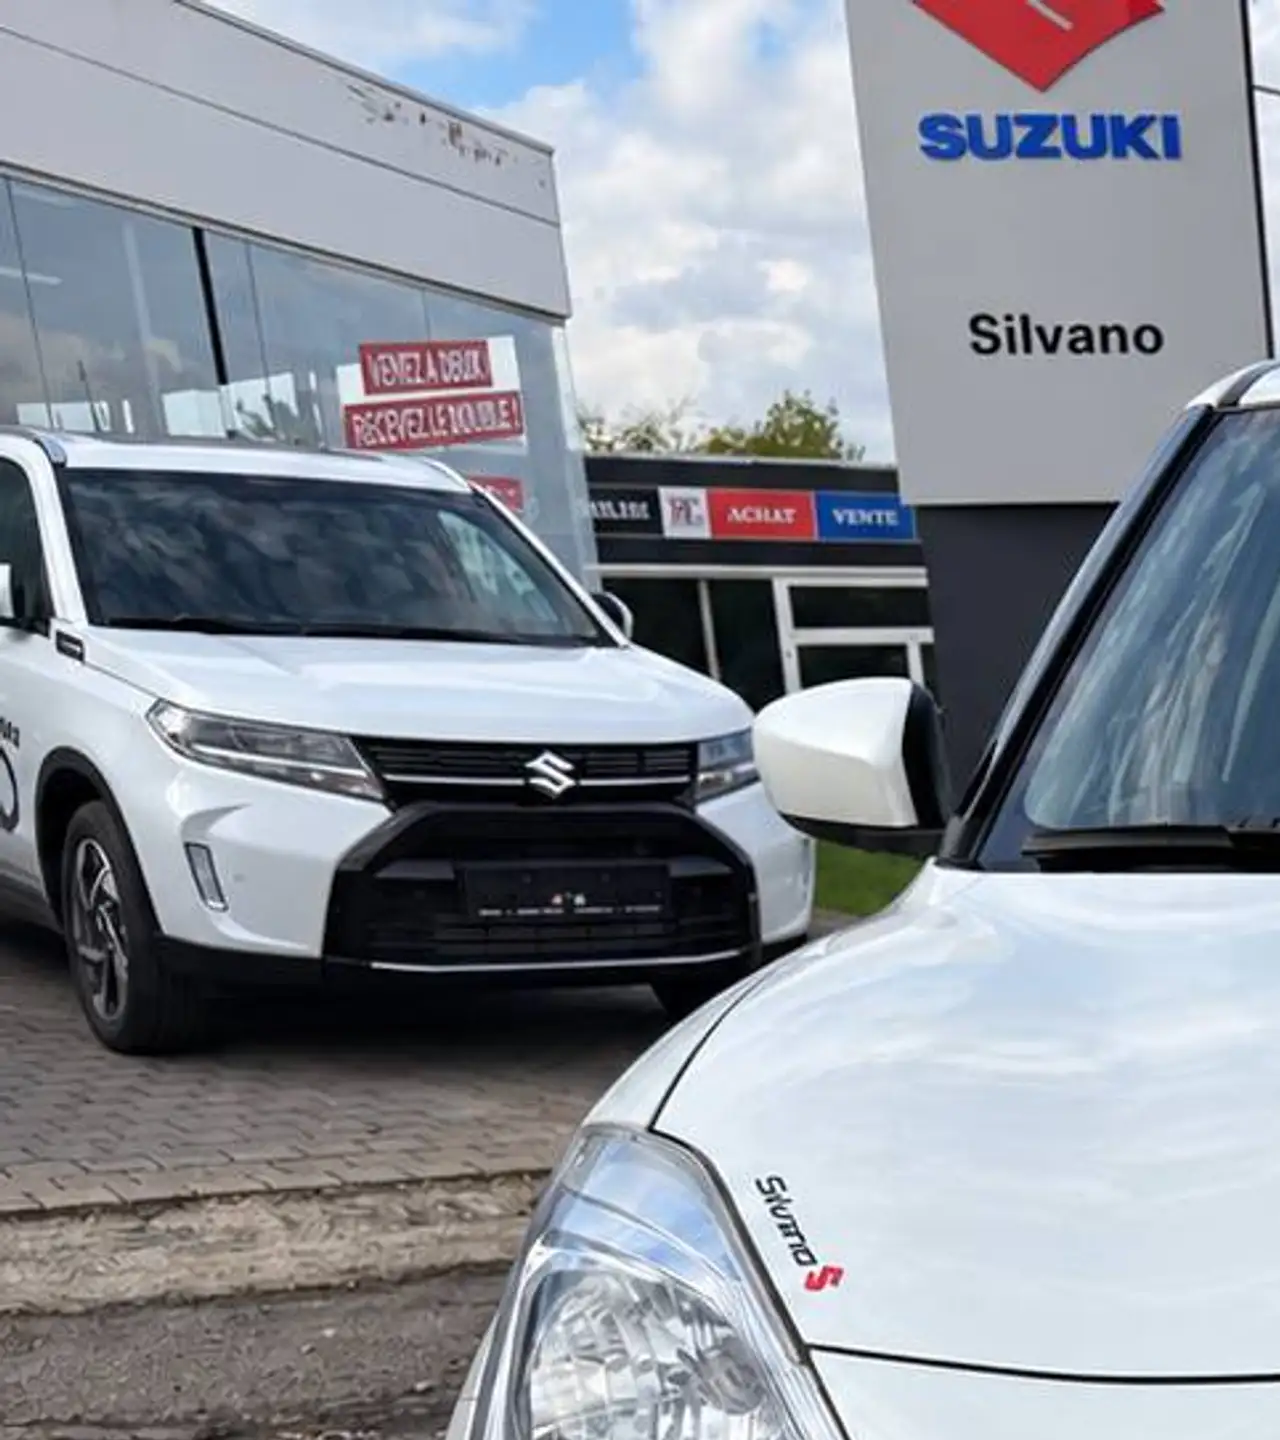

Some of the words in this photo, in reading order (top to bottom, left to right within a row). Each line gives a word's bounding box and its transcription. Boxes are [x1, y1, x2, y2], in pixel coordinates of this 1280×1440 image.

[918, 113, 1182, 161] SUZUKI
[968, 313, 1165, 356] Silvano
[727, 507, 798, 525] ACHAT
[831, 507, 900, 527] VENTE
